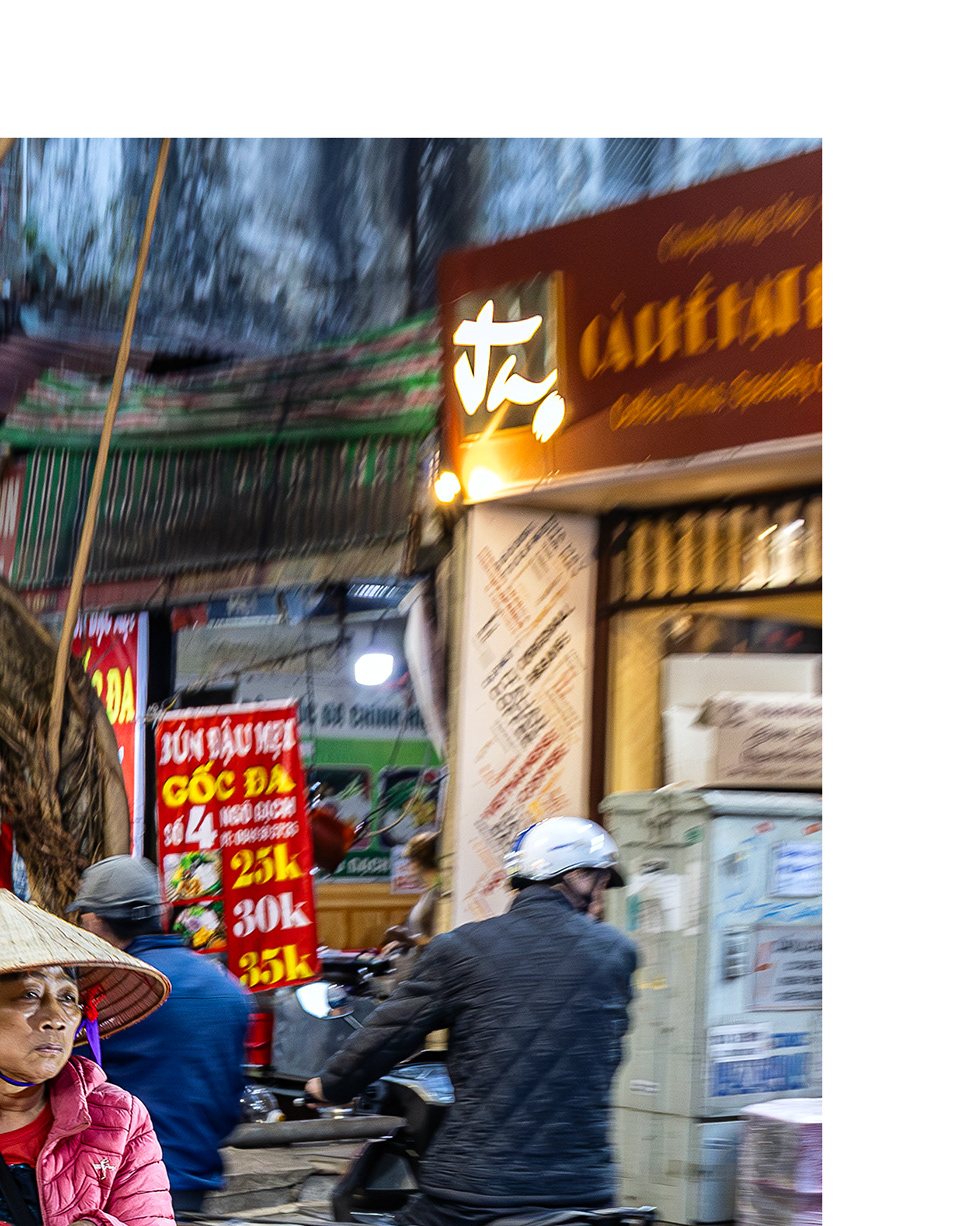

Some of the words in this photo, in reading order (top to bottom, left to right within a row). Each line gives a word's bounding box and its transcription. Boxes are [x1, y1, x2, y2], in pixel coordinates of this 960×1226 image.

[158, 721, 205, 766] BÚN
[162, 760, 236, 808] GỐC
[243, 763, 297, 798] ĐA
[185, 805, 218, 850] 4
[230, 842, 304, 890] 25k
[232, 892, 313, 938] 30k
[239, 944, 315, 988] 35k
